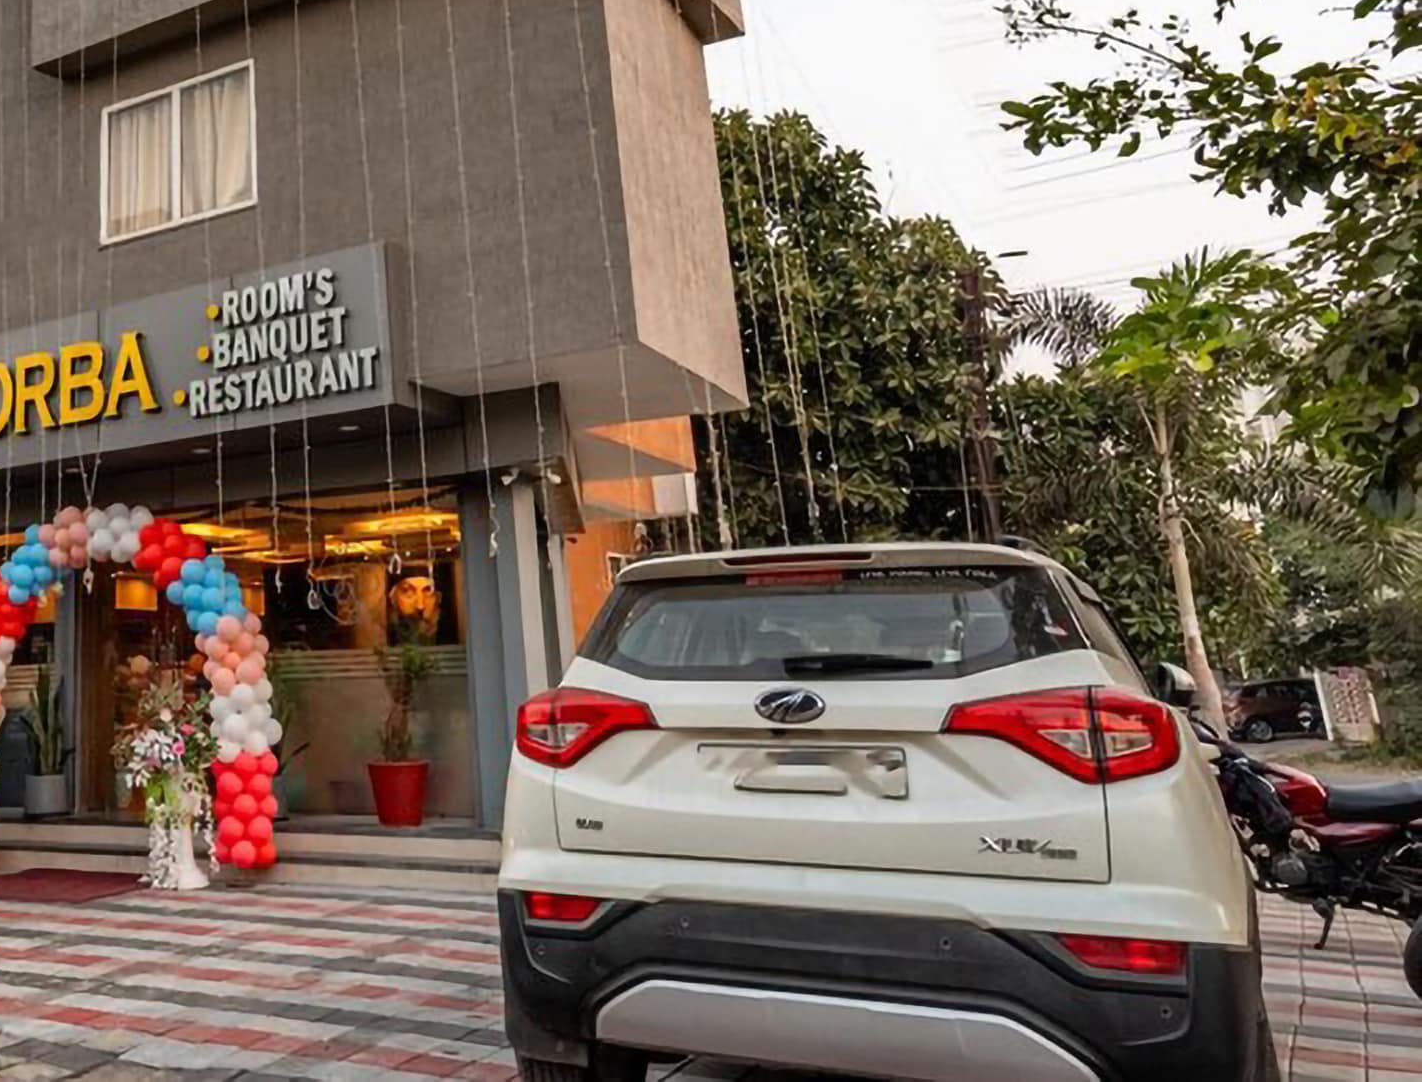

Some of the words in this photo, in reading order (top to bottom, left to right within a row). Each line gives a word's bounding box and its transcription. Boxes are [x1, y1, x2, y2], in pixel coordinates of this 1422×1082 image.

[222, 267, 335, 327] ROOM'S
[212, 306, 346, 369] BANQUET
[189, 345, 377, 417] RESTAURANT
